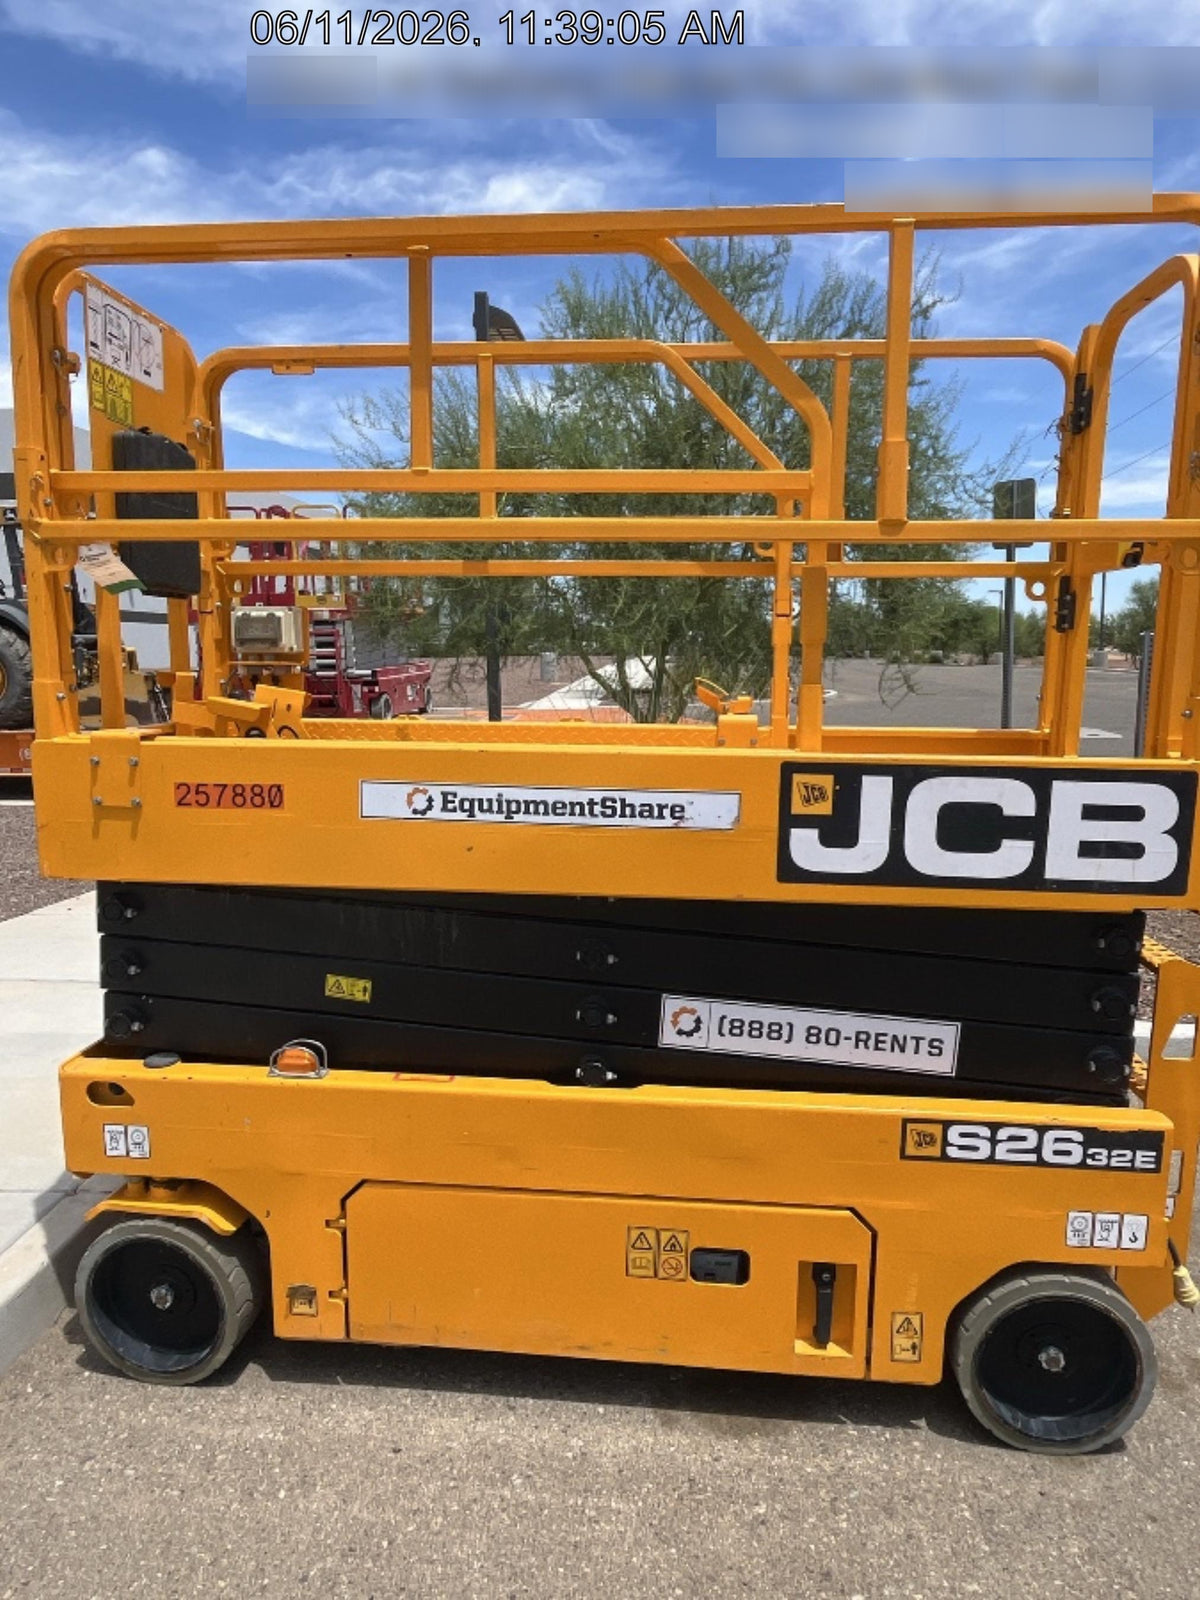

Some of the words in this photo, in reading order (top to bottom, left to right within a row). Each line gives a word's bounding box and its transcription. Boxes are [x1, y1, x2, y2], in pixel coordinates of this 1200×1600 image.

[176, 783, 283, 808] 257880
[440, 791, 686, 821] EquipmentShare
[798, 782, 829, 806] JCB
[789, 774, 1180, 882] JCB
[718, 1015, 794, 1044] (888)
[805, 1025, 944, 1057] 80-RENTS
